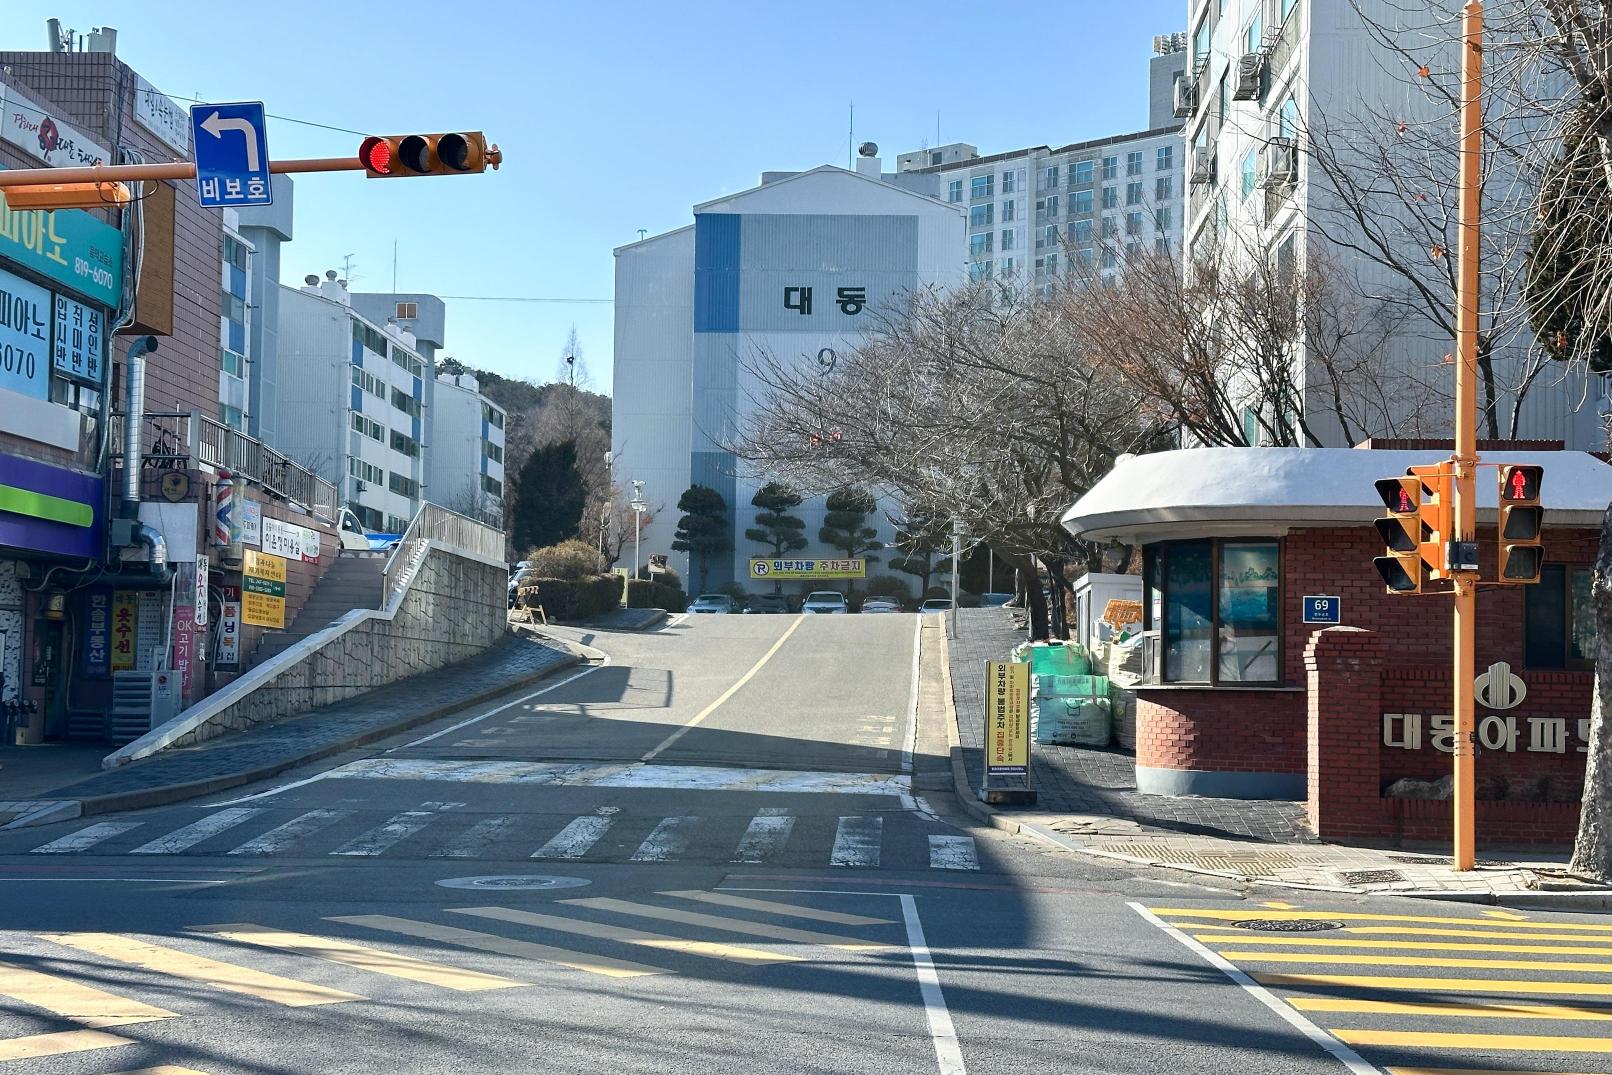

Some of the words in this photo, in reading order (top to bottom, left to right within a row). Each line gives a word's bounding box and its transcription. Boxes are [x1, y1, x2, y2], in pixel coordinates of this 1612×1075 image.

[201, 176, 267, 201] 비보호
[74, 256, 113, 290] 819-6070
[784, 287, 866, 315] 대동
[56, 297, 67, 369] 입시반
[72, 304, 83, 374] 취미반
[87, 311, 98, 379] 성인반
[0, 342, 35, 379] 070
[818, 348, 836, 376] 9
[773, 561, 815, 571] 외부차량
[819, 561, 860, 571] 주차금지
[1314, 599, 1329, 611] 69
[115, 607, 133, 654] 옷수선
[177, 620, 192, 631] OK
[997, 664, 1006, 696] 외부차량
[996, 698, 1006, 729] 불법주차
